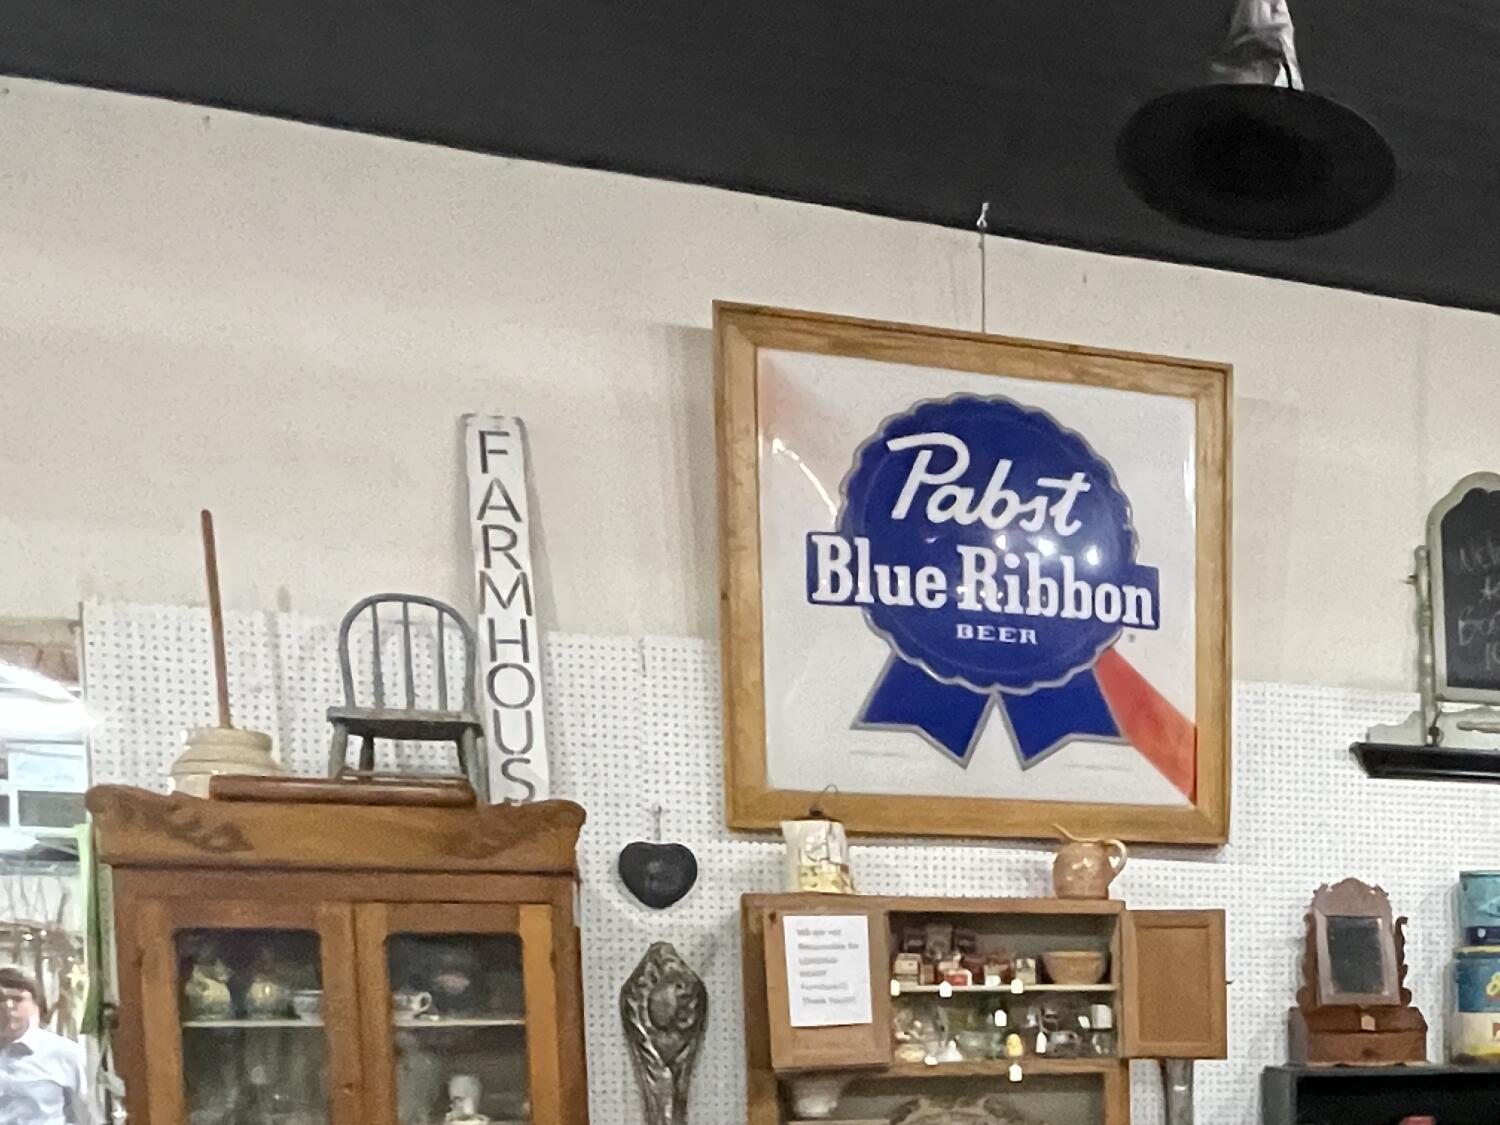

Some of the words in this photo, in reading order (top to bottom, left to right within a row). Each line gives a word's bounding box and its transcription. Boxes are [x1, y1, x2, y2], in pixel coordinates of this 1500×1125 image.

[887, 431, 1091, 536] Pabst
[476, 429, 537, 804] FARMHOUS
[811, 533, 947, 608] Blue
[957, 544, 1157, 629] Ribbon
[955, 622, 1038, 646] BEER
